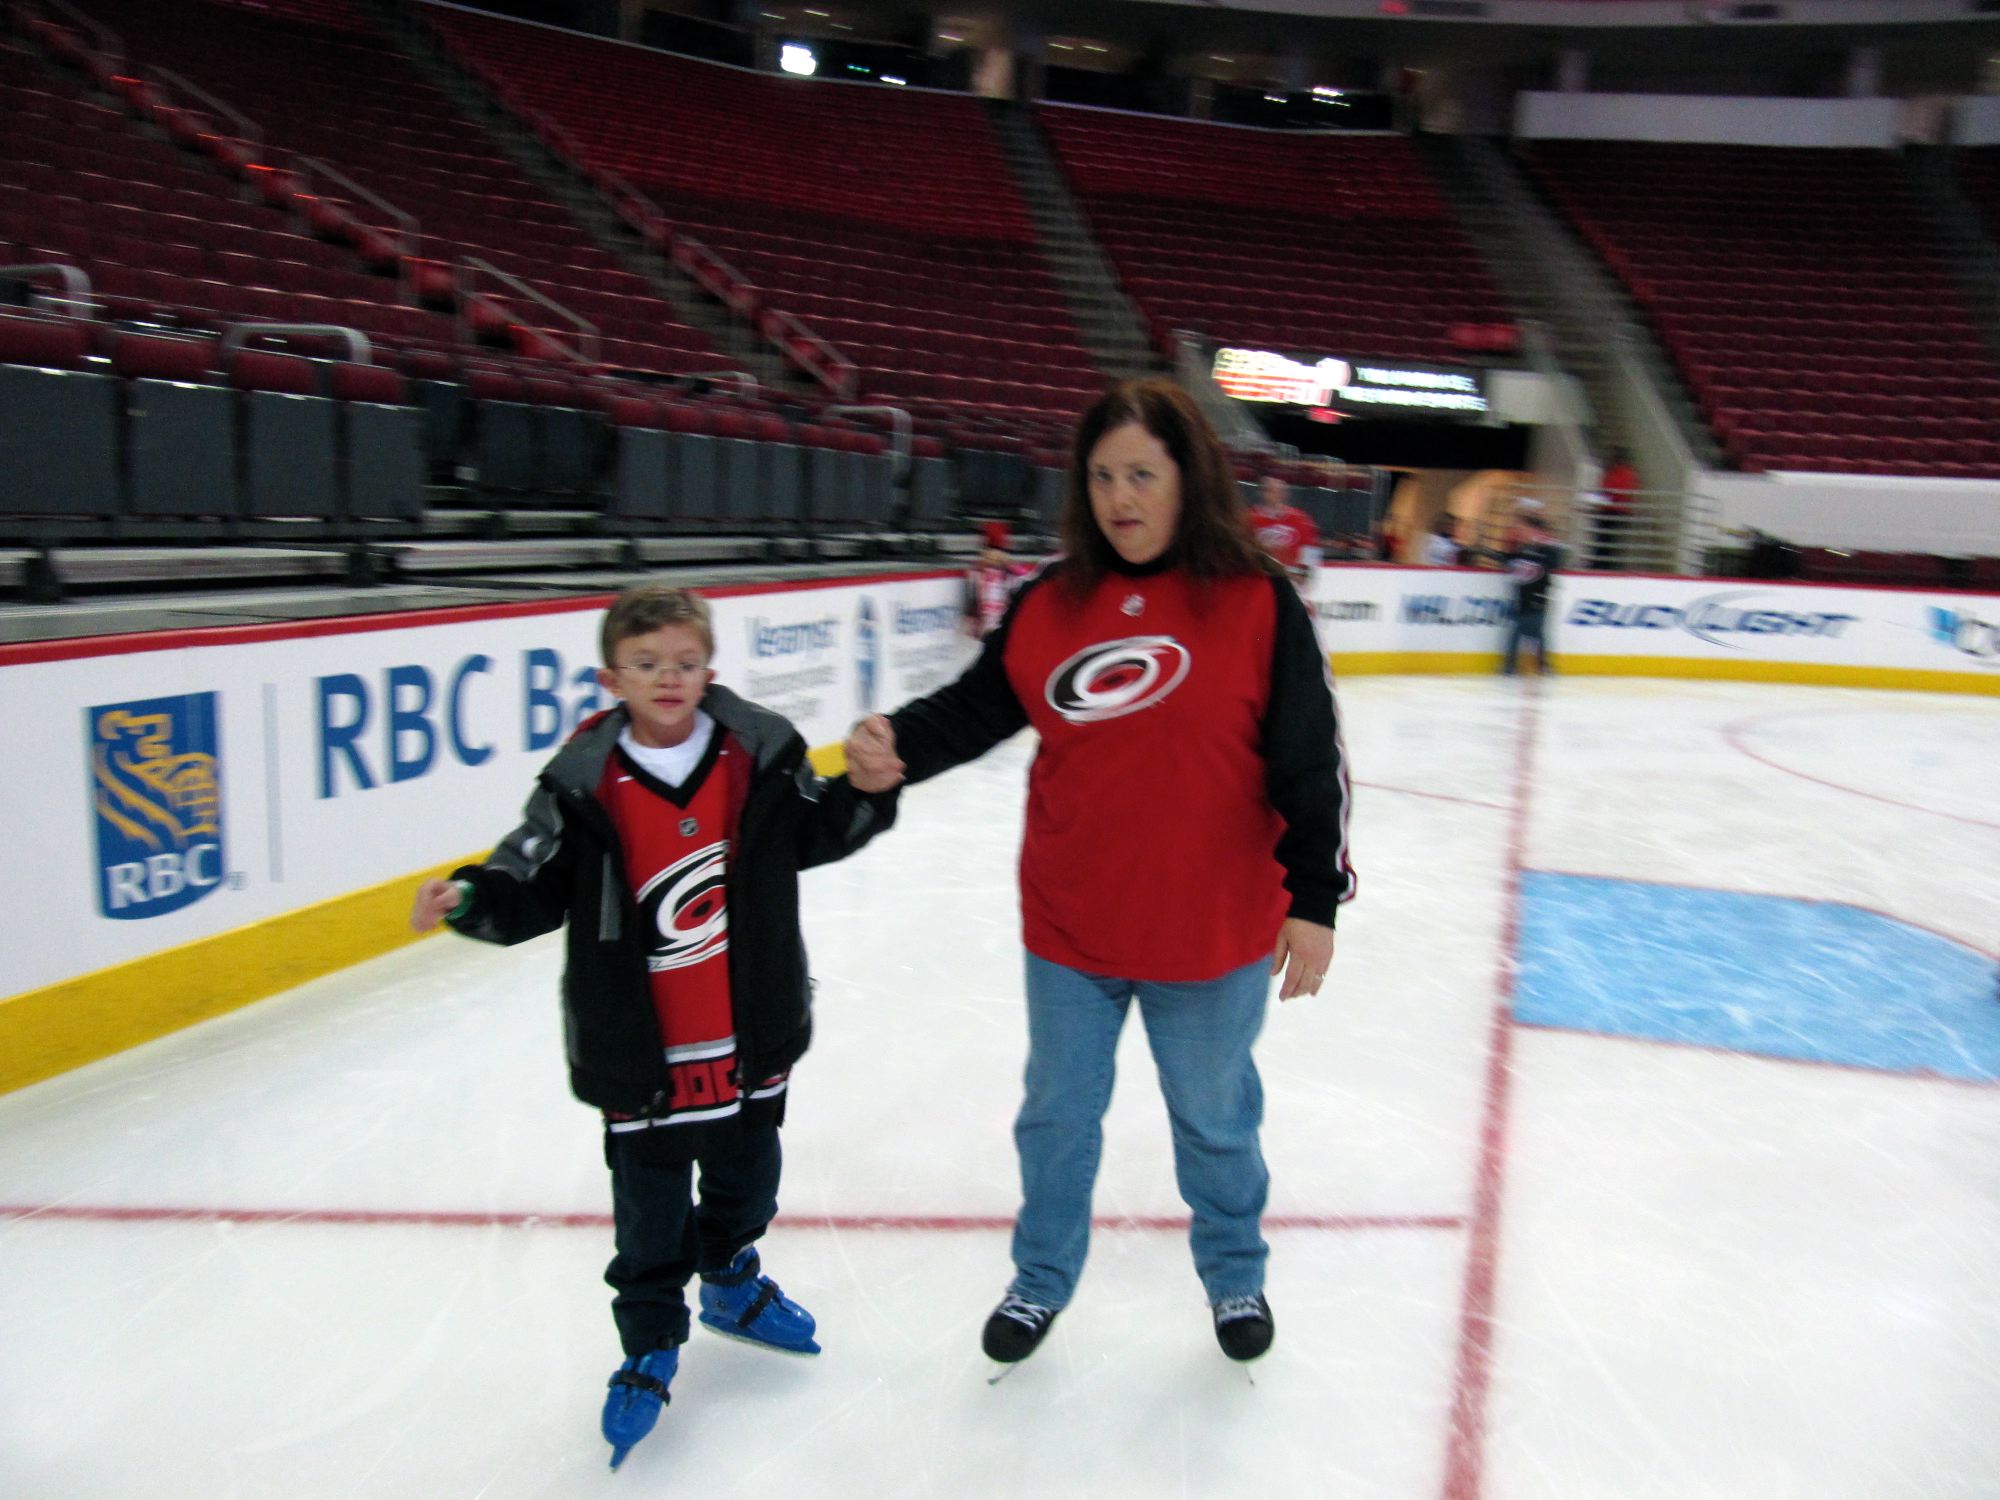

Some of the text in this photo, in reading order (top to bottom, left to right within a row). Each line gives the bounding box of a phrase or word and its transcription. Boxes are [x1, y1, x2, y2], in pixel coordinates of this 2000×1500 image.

[314, 647, 602, 799] RBC Ba
[105, 843, 222, 909] RBC
